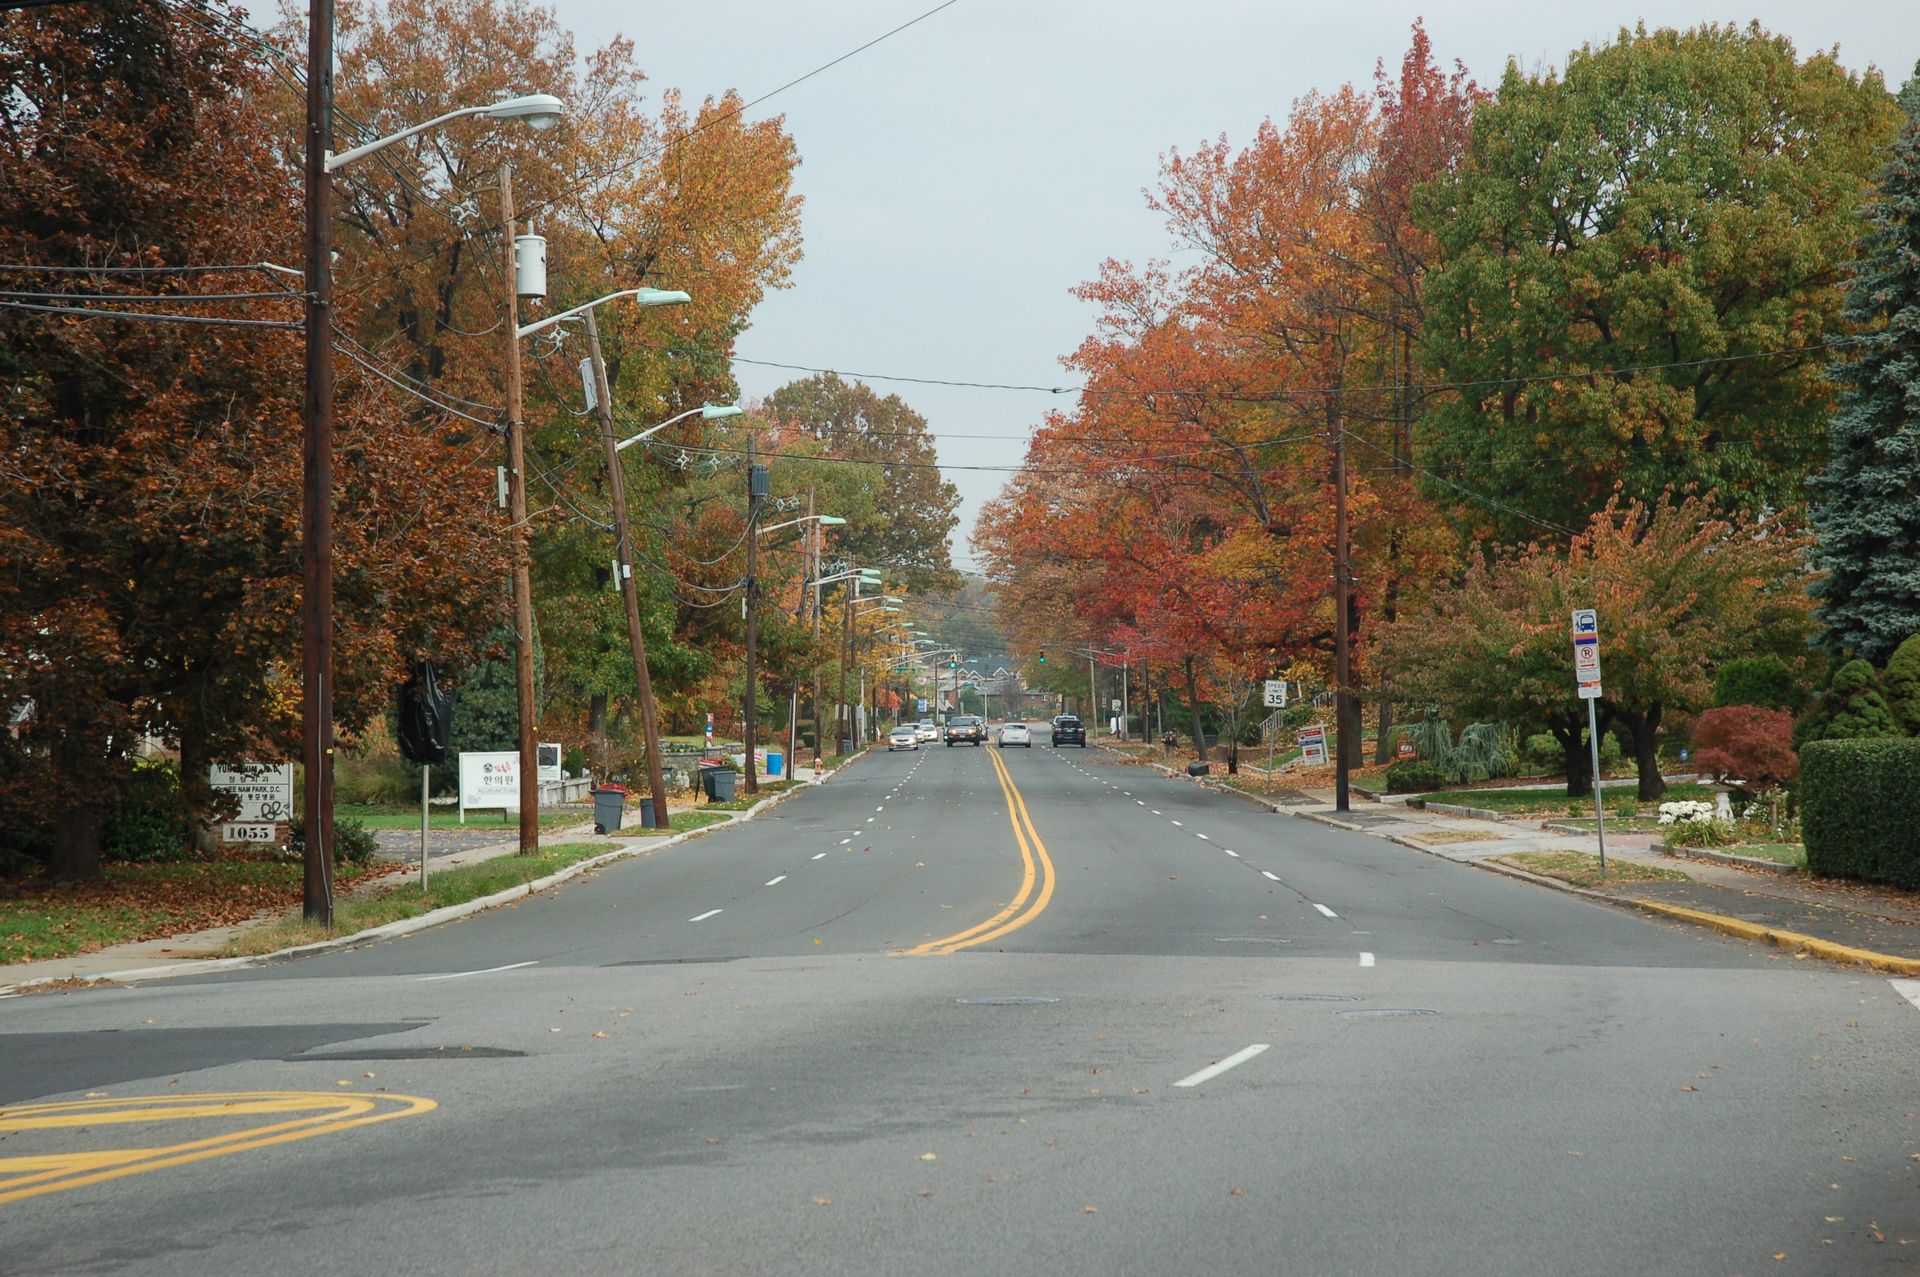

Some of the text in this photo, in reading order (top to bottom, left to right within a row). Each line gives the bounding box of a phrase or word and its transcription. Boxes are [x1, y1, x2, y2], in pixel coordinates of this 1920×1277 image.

[1268, 694, 1282, 704] 35
[484, 775, 513, 785] 한의원
[230, 827, 269, 839] 1055
